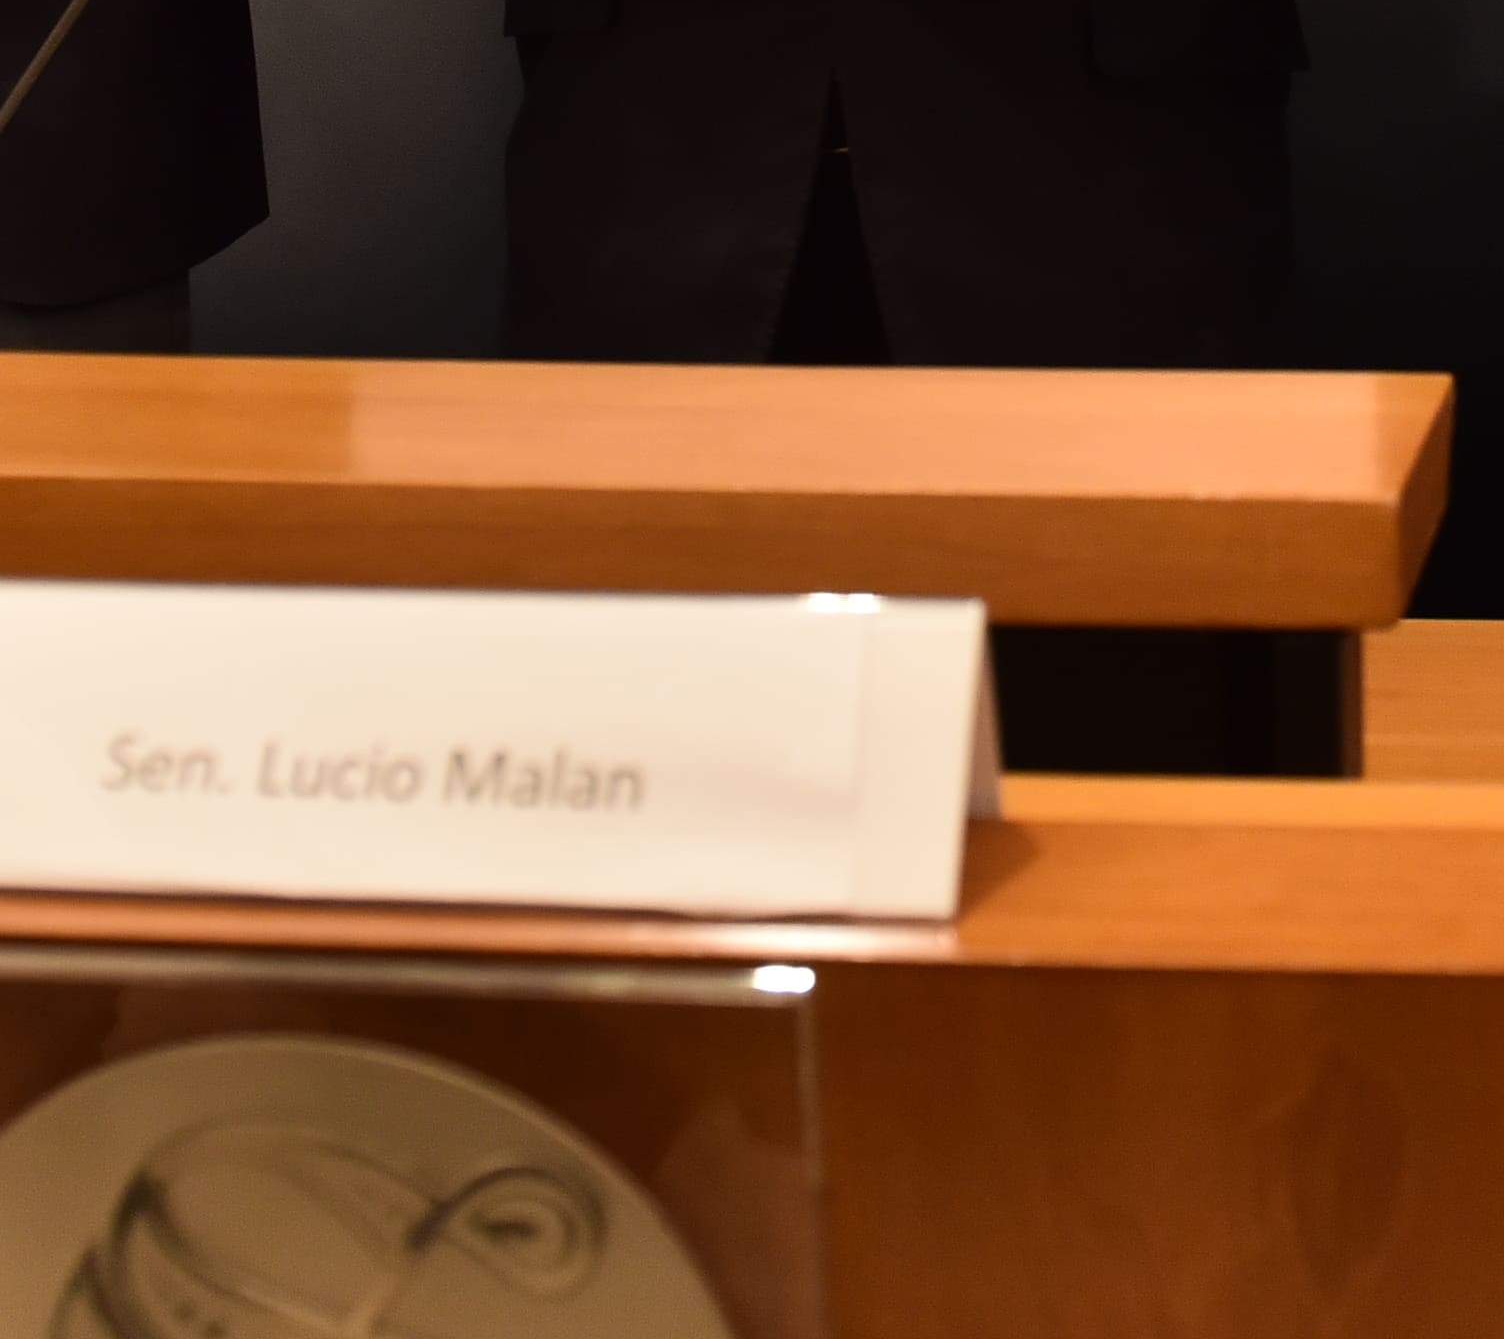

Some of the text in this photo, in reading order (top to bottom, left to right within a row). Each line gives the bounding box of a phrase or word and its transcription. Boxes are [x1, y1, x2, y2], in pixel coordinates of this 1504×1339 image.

[102, 733, 647, 811] Sen. Lucio Malan
